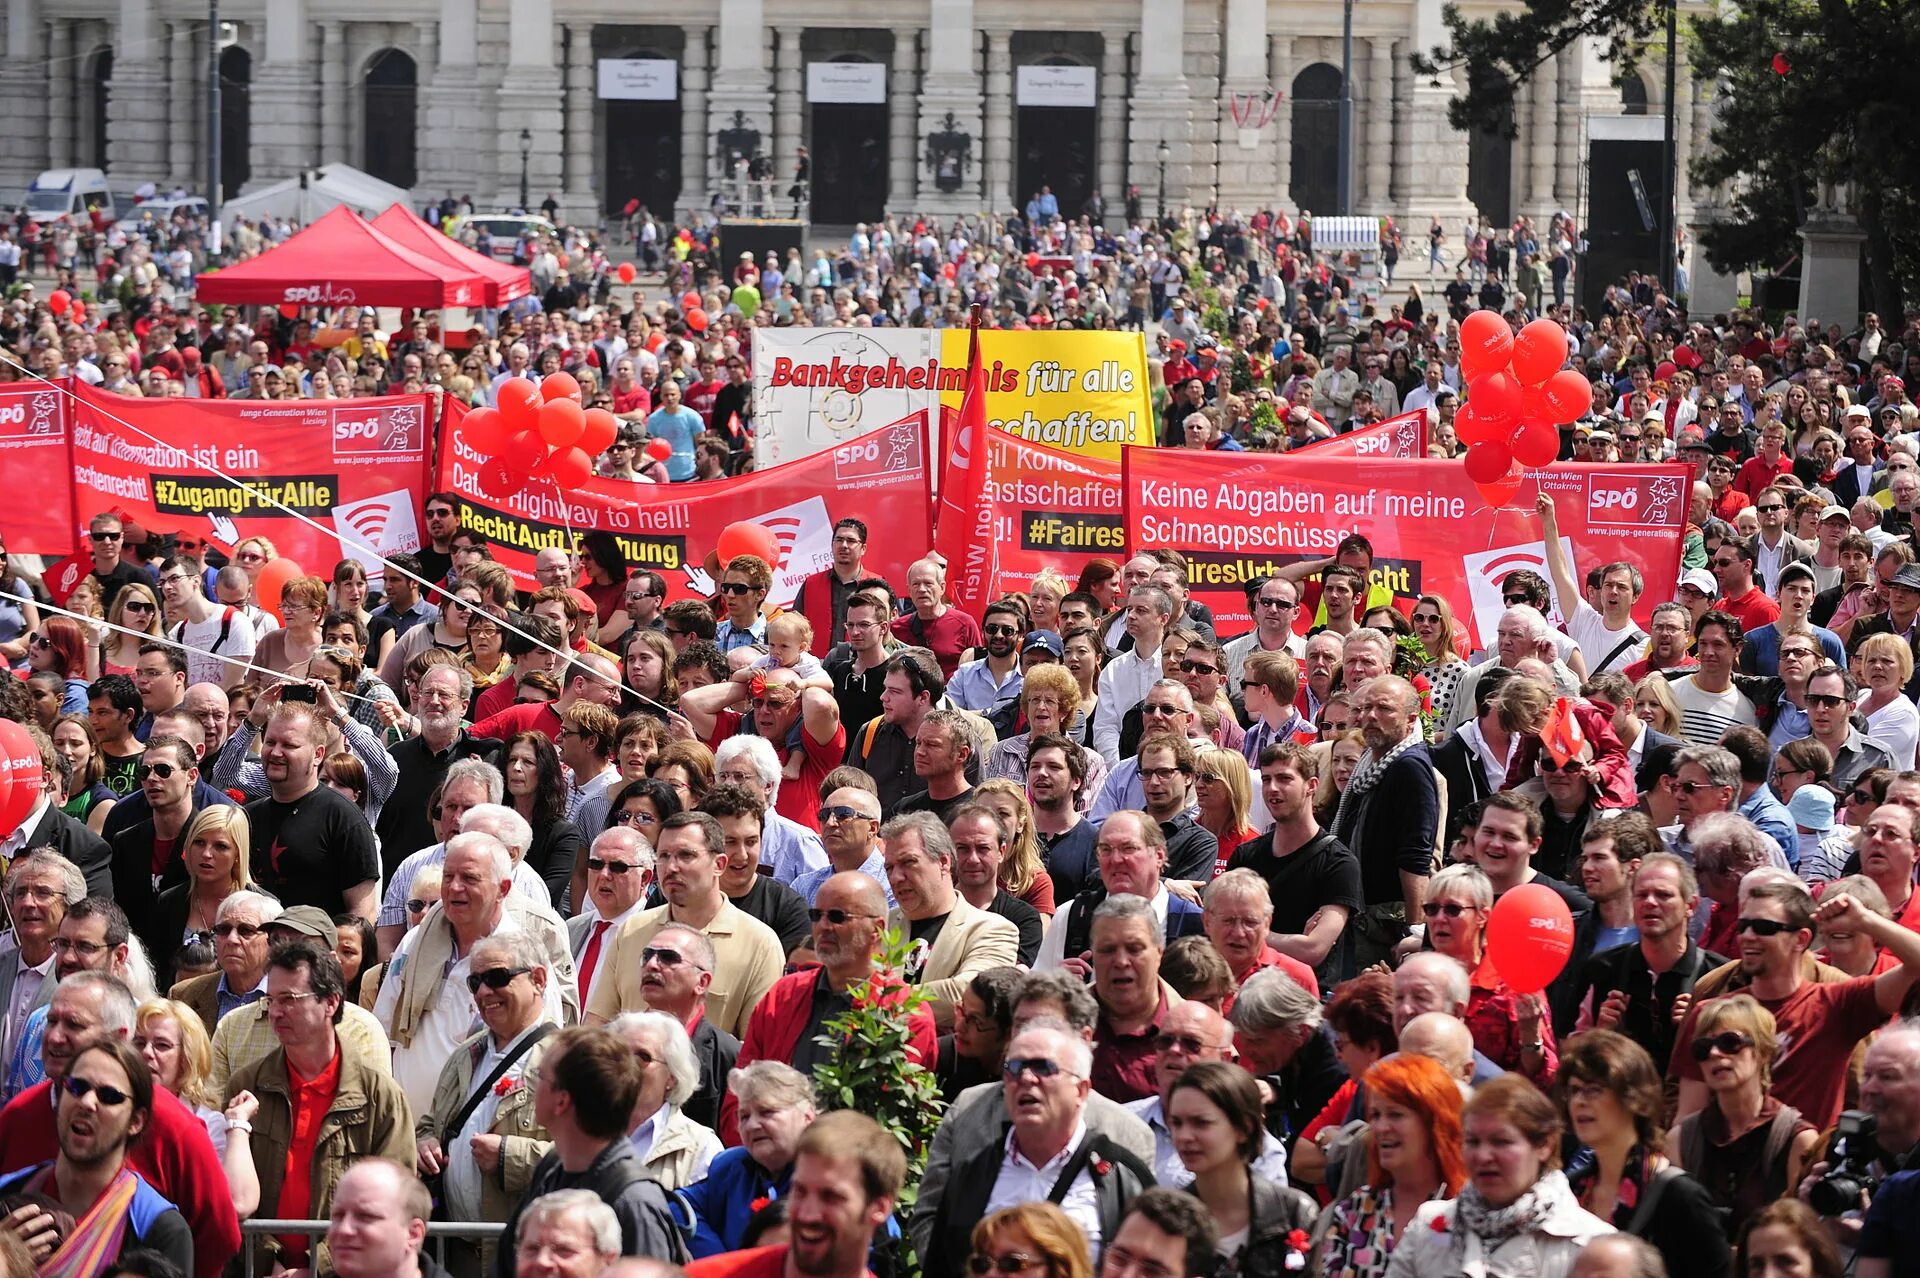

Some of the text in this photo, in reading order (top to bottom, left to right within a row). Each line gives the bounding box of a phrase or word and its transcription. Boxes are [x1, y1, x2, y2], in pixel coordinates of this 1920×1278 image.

[283, 285, 320, 302] SPÖ
[1026, 360, 1076, 397] für
[1082, 360, 1134, 392] alle
[0, 403, 25, 424] PÖ
[240, 408, 327, 418] Junge Generation Wien
[302, 418, 327, 426] Liesing
[335, 418, 378, 439] SPÖ
[836, 440, 879, 465] SPÖ
[1357, 433, 1390, 454] SPÖ
[194, 443, 219, 469] ist
[225, 444, 258, 469] ein
[334, 454, 423, 465] www.junge-generation.at
[836, 472, 923, 491] www.junge-generation.at
[1543, 481, 1582, 491] Ottakring
[1560, 472, 1582, 480] Wien
[155, 480, 330, 514] #ZugangFürAlle
[1141, 479, 1208, 510] Keine
[1215, 483, 1325, 518] Abgaben
[1334, 488, 1377, 516] auf
[1385, 490, 1465, 519] meine
[1590, 487, 1638, 510] SPÖ
[606, 505, 630, 528] to
[638, 504, 690, 529] hell!
[398, 532, 416, 543] Free
[12, 756, 33, 770] SPÖ
[1529, 918, 1555, 931] SPÖ
